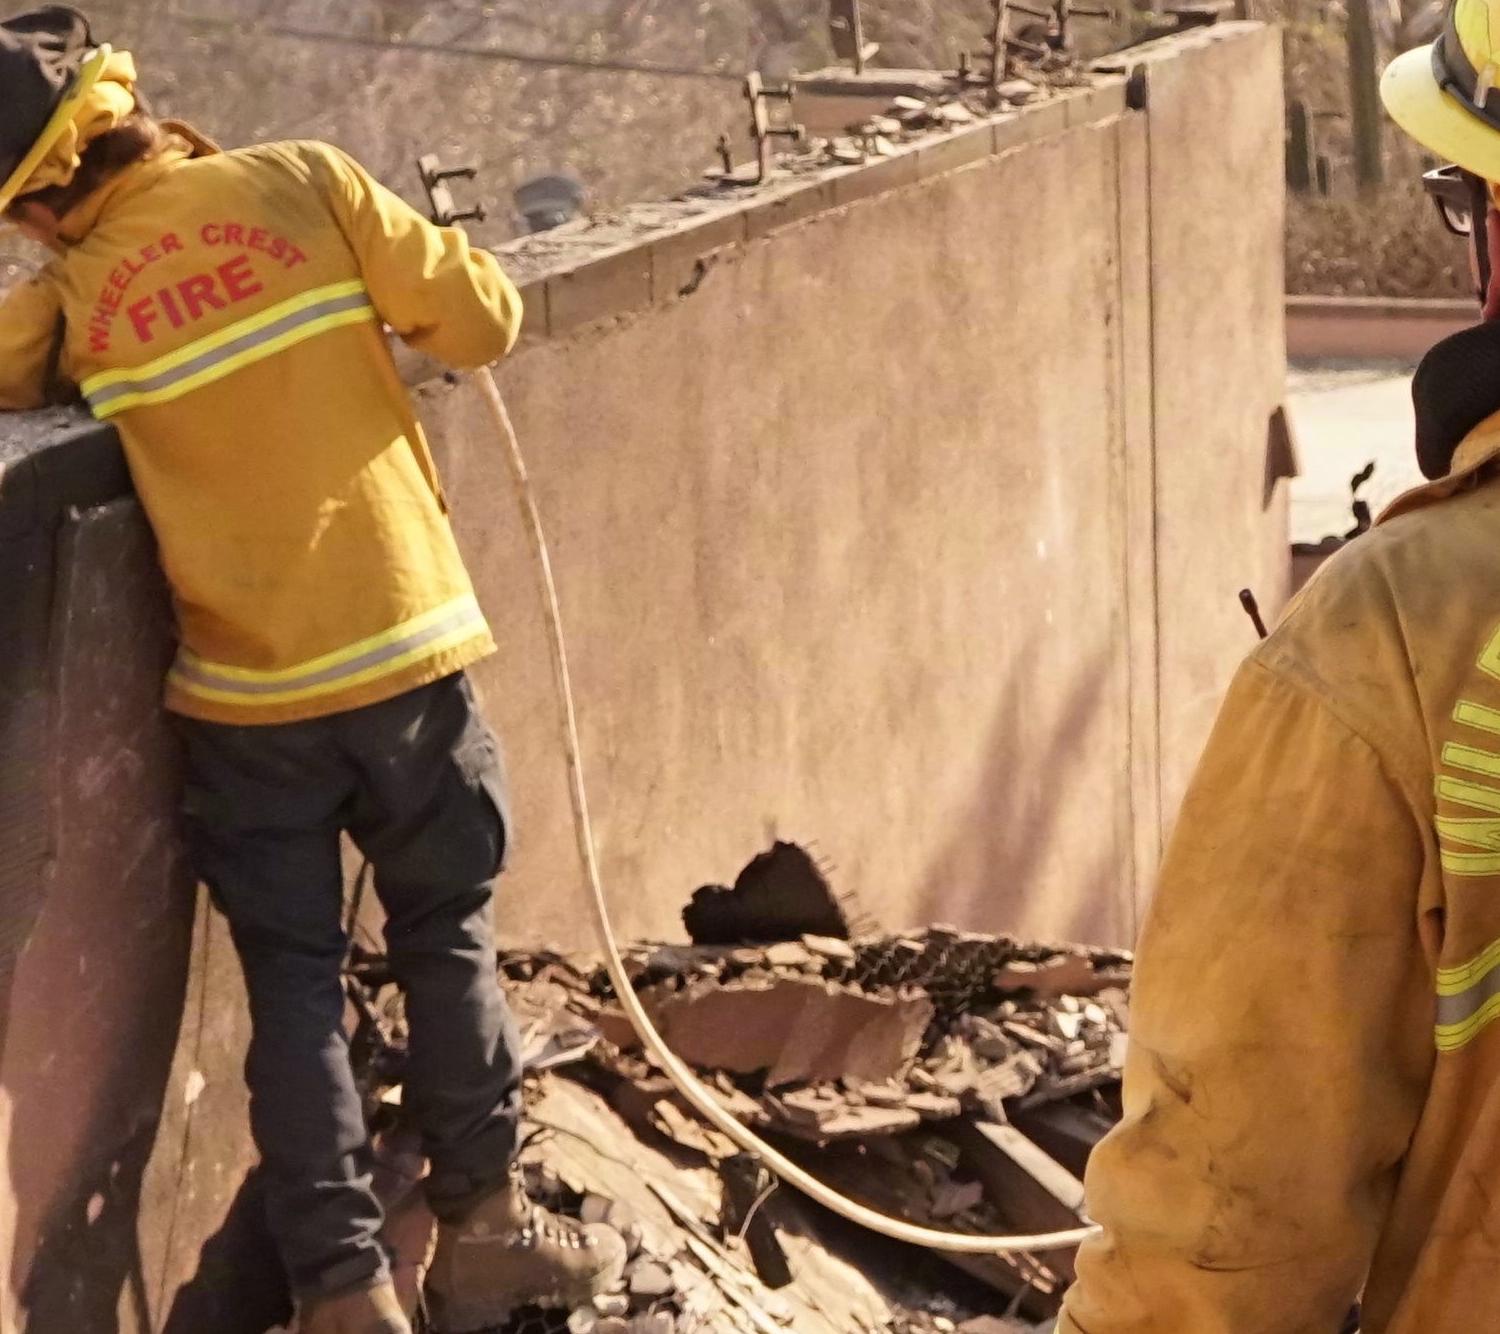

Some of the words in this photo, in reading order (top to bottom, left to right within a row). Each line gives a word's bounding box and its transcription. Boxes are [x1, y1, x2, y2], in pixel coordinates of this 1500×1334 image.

[88, 232, 184, 353] WHEELER
[200, 223, 307, 269] CREST
[126, 254, 264, 344] FIRE
